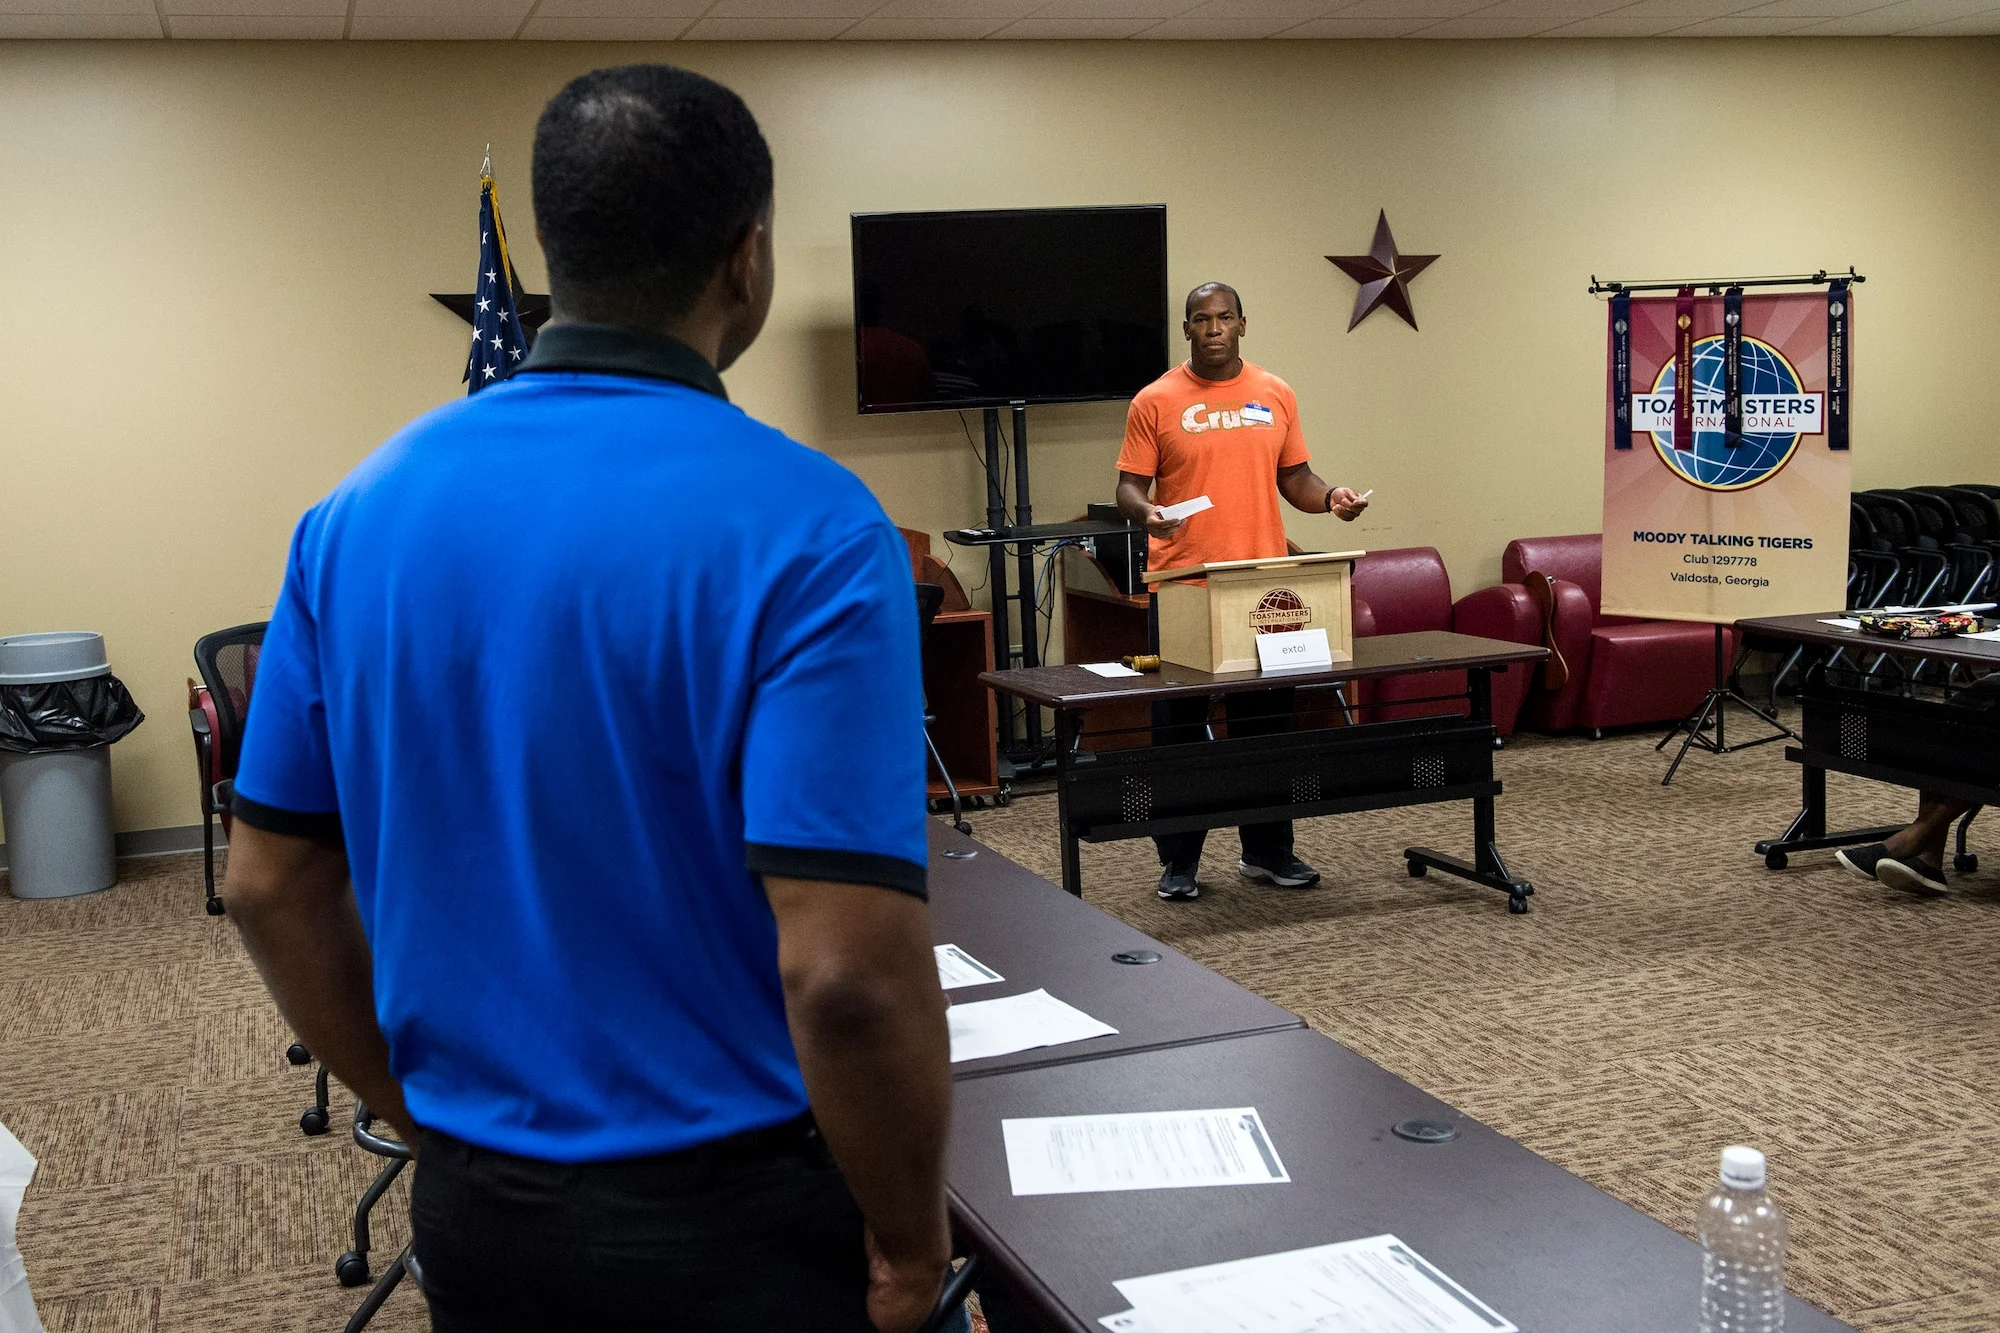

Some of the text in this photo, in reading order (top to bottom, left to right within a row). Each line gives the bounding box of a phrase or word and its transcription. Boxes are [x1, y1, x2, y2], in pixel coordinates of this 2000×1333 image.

[1638, 399, 1815, 414] TOTMSTERS
[1181, 400, 1275, 433] Cru
[1657, 417, 1794, 428] INRNAIONAL
[1633, 531, 1813, 549] MOODY TALKING TIGERS
[1683, 554, 1757, 567] Club 1297778
[1670, 572, 1769, 588] Valdosta, Georgia
[1252, 610, 1309, 620] TOASTMASTERS
[1282, 643, 1307, 654] extol
